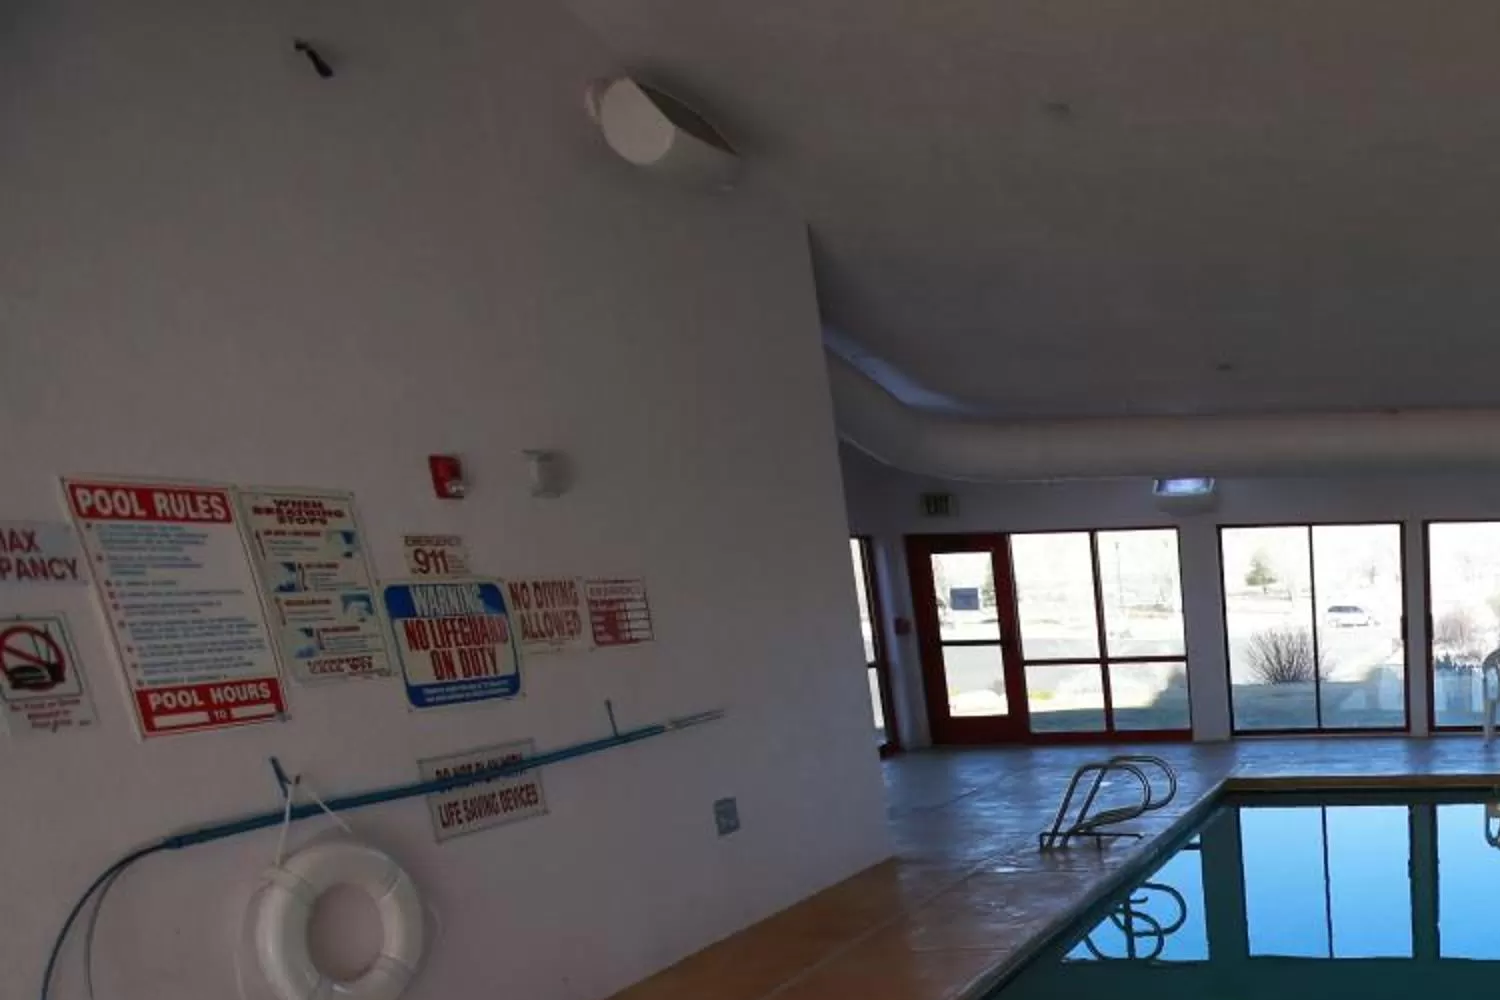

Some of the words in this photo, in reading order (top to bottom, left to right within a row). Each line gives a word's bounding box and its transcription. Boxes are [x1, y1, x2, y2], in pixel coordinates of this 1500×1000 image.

[74, 487, 147, 517] POOL
[154, 490, 227, 520] RULES
[0, 556, 78, 582] PANCY
[414, 548, 449, 574] 911
[508, 581, 531, 610] NO
[533, 580, 579, 610] DIVING
[405, 617, 430, 651] NO
[430, 615, 509, 649] LIFEGUARD
[521, 610, 582, 640] ALLOWED
[430, 649, 457, 681] ON
[459, 647, 499, 679] DUTY
[149, 690, 204, 713] POOL
[209, 682, 271, 702] HOURS
[438, 801, 463, 829] LIFE
[463, 790, 501, 824] SAVING
[500, 783, 539, 815] DEVICES
